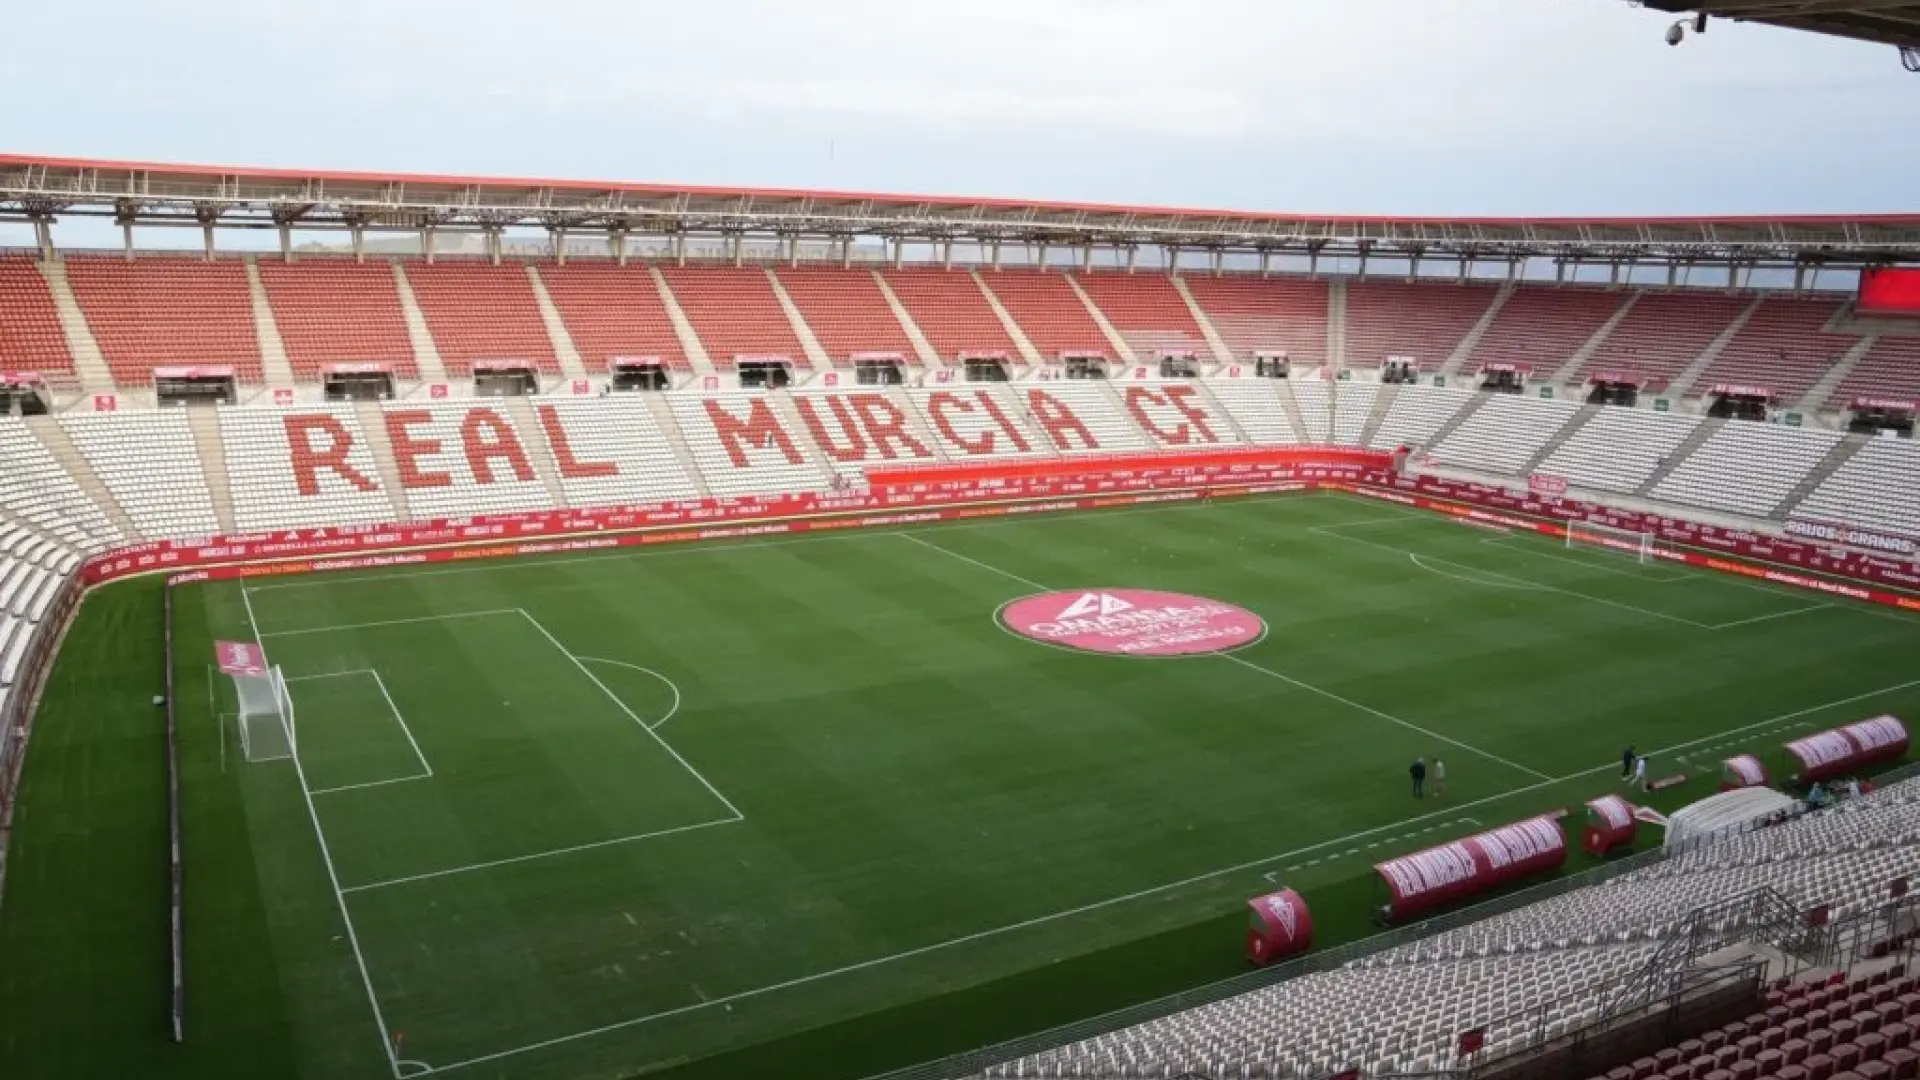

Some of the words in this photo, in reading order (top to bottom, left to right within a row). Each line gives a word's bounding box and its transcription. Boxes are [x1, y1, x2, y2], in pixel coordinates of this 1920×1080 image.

[284, 404, 619, 496] REAL
[702, 388, 1100, 468] MURCIA
[1124, 384, 1221, 445] CF
